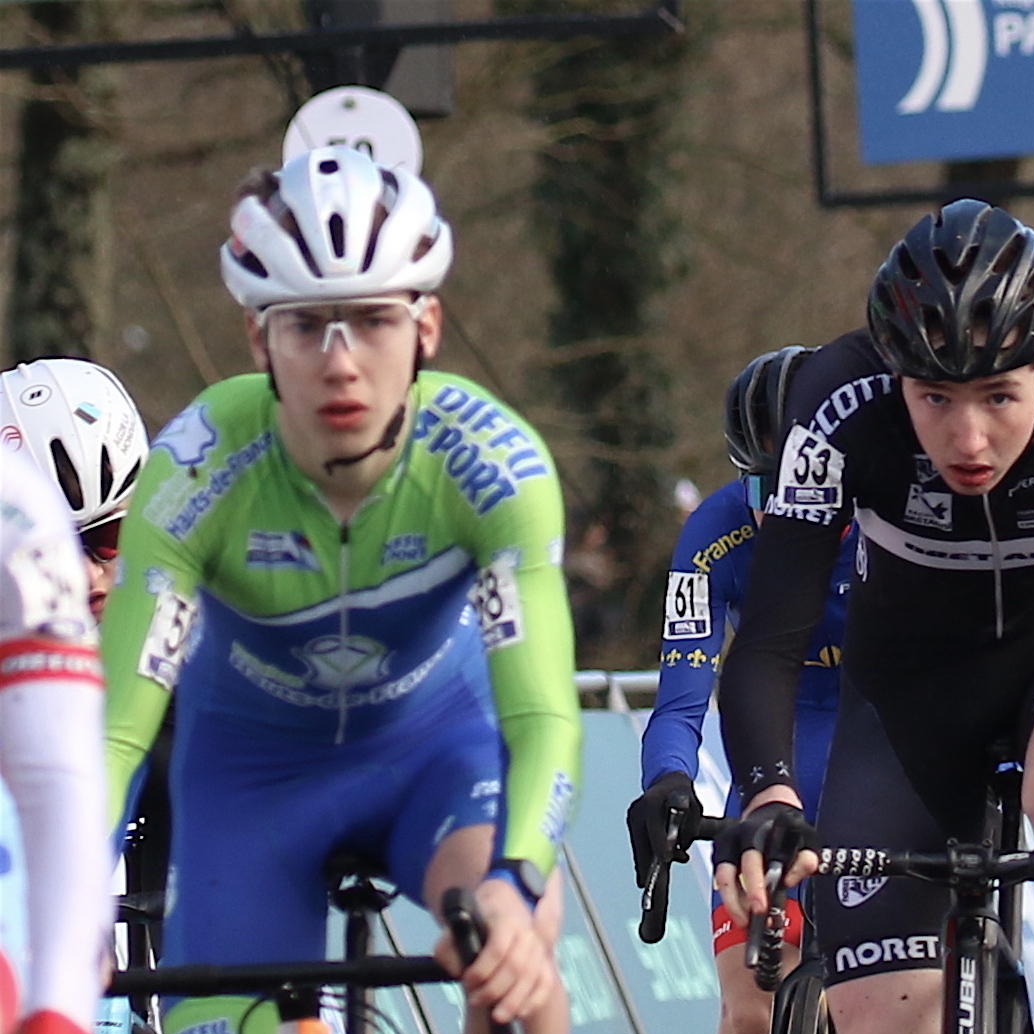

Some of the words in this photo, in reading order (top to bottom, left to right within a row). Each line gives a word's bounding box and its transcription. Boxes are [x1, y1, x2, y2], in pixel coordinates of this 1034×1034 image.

[434, 385, 548, 481] DIFFU
[412, 409, 516, 517] SPORT
[794, 436, 832, 486] 53
[675, 576, 696, 618] 61
[836, 935, 939, 973] NORET
